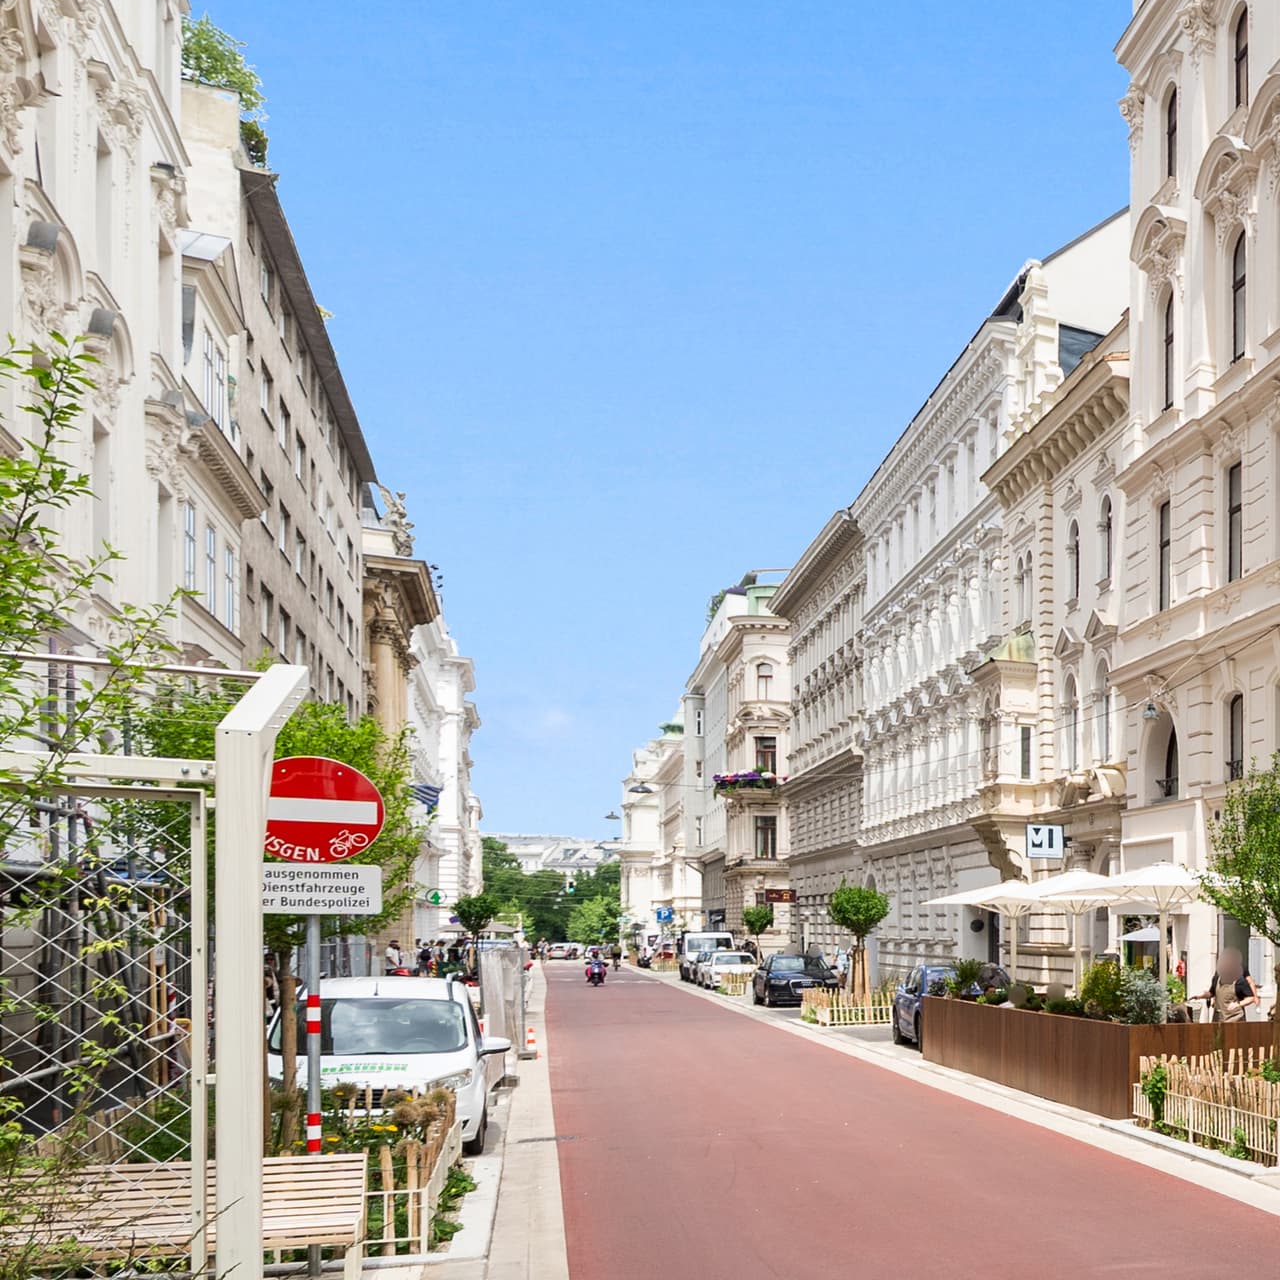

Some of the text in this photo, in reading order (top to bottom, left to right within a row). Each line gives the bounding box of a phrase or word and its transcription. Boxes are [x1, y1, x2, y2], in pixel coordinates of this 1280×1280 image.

[264, 870, 359, 881] ausgenommen
[262, 896, 370, 909] er Bundespolizei
[661, 910, 669, 919] P
